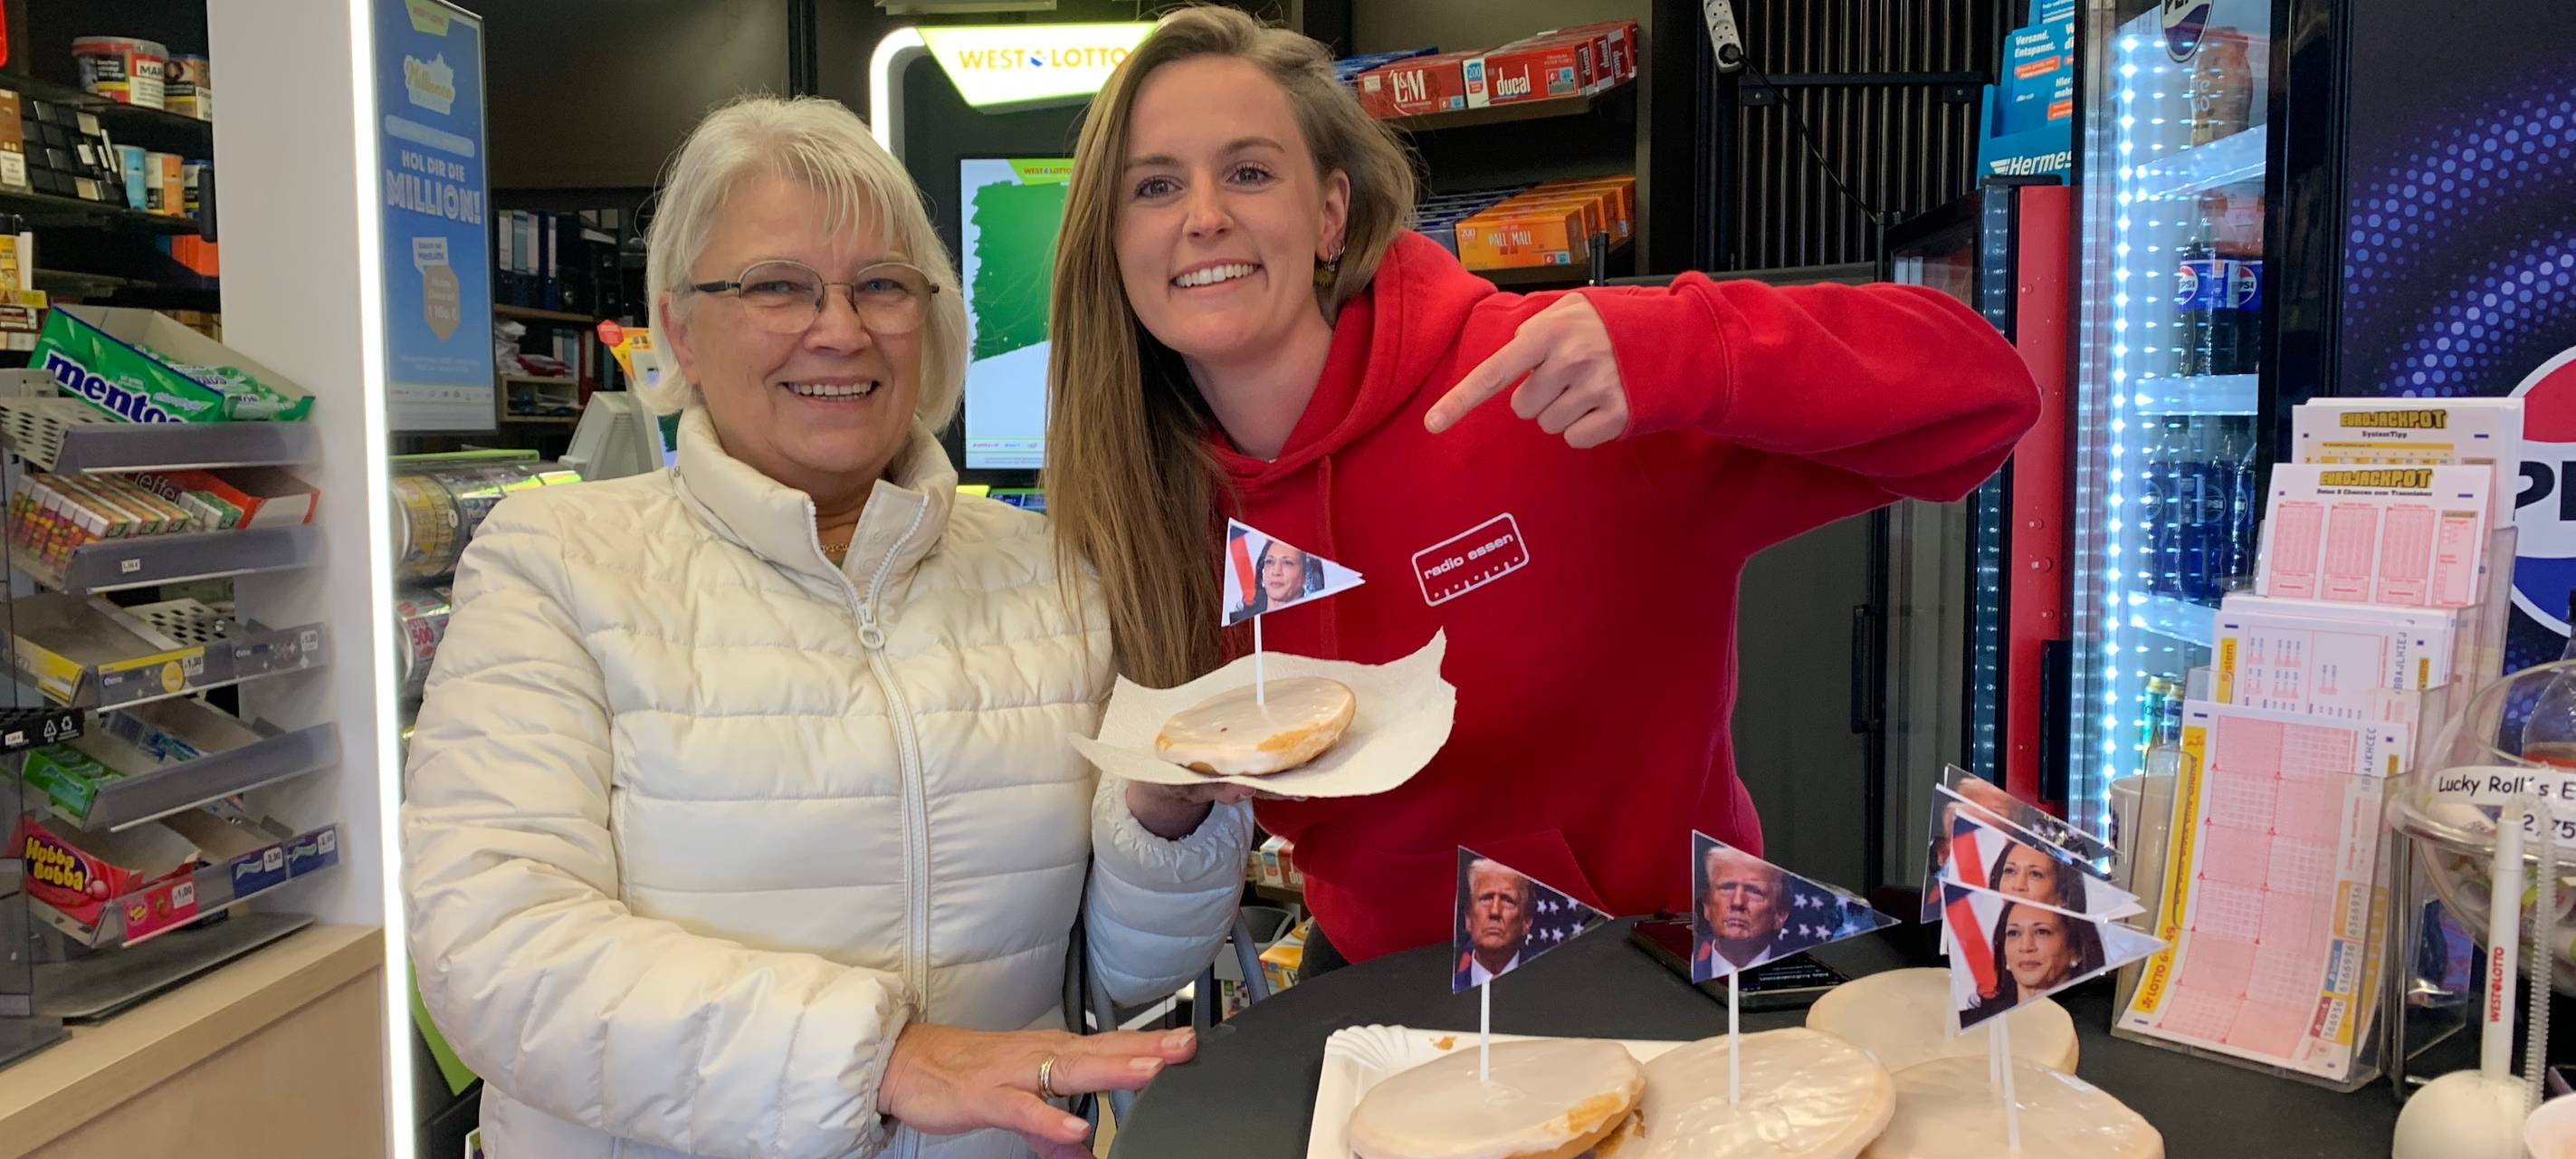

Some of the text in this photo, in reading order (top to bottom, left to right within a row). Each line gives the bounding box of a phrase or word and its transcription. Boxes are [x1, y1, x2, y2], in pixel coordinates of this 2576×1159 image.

[2014, 42, 2056, 58] Entspannt.
[2016, 30, 2049, 46] Versand.
[959, 47, 1130, 70] WEST LOTTO
[1598, 39, 1609, 69] ducal
[1468, 65, 1482, 78] 200
[1496, 63, 1531, 96] ducal
[1388, 70, 1426, 103] L&M
[402, 149, 465, 183] HOL DIR DIE
[1023, 167, 1073, 175] WEST LOTTO
[2008, 150, 2071, 176] Hermes
[386, 168, 482, 225] MILLION!
[1461, 228, 1476, 240] 200
[1488, 231, 1532, 247] PALL MALL
[46, 350, 186, 423] mento
[2340, 409, 2448, 428] EUROJACKPOT
[2361, 430, 2408, 439] SystemTipp
[2319, 469, 2433, 489] EUROJACKPOT
[1424, 533, 1514, 580] radio essen
[2438, 774, 2481, 797] Lucky
[25, 837, 75, 868] Hubba
[33, 861, 84, 892] Bubba
[2147, 963, 2167, 997] LOTTO
[2490, 946, 2504, 1022] WEST LOTTO
